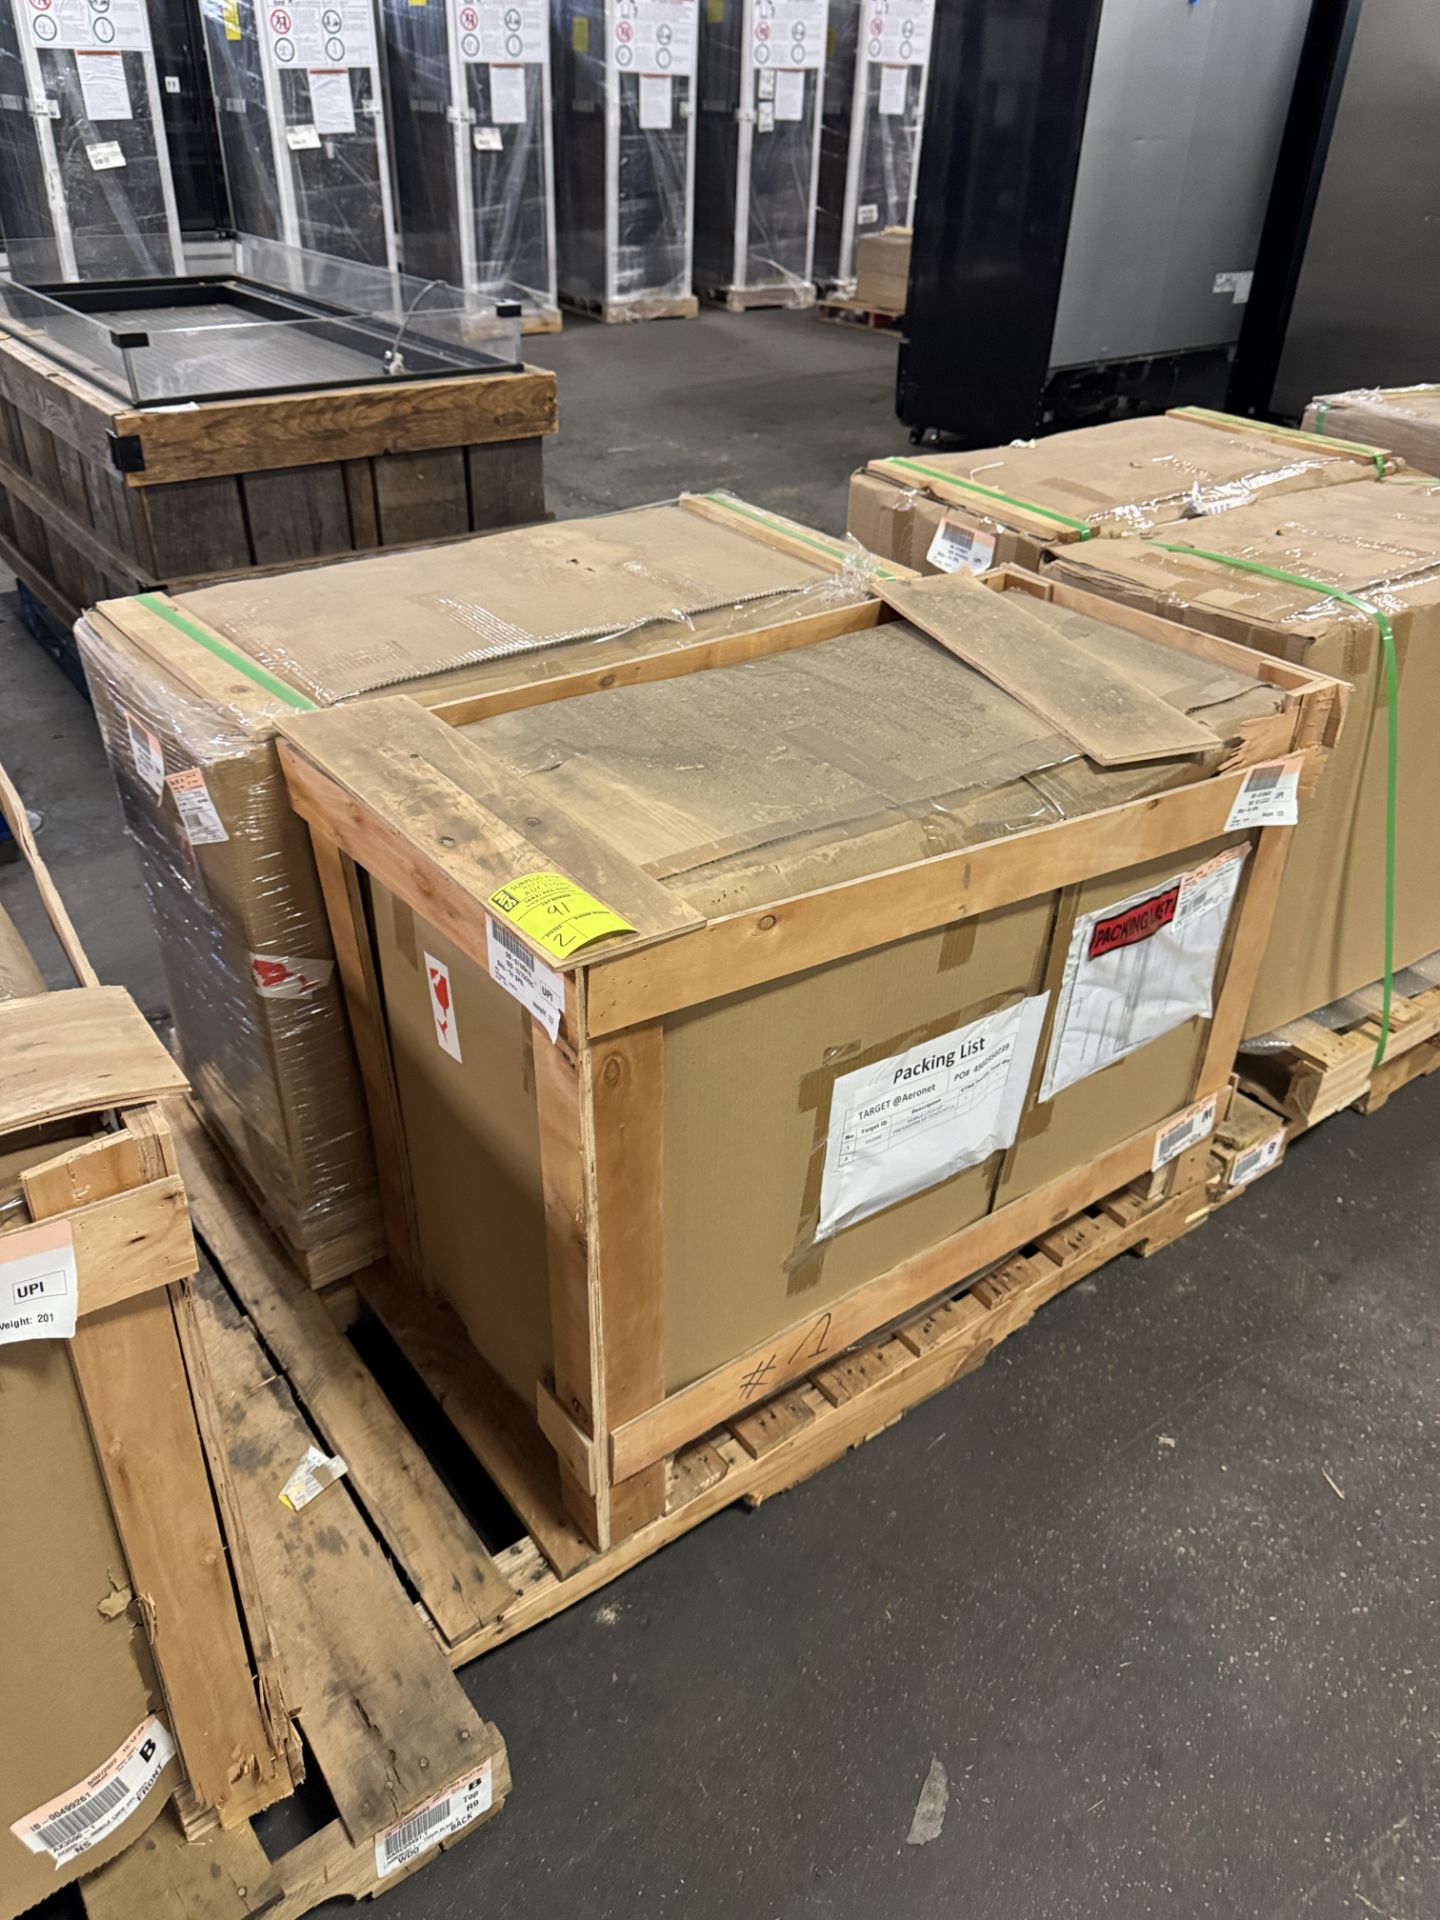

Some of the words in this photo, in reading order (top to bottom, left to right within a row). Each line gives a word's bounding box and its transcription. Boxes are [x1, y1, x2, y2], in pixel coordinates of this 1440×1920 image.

[547, 902, 570, 916] 91
[1095, 911, 1148, 947] PACKING
[553, 933, 577, 948] 2
[541, 985, 553, 1001] UPI
[893, 1050, 956, 1085] Packing
[960, 1037, 986, 1060] List
[858, 1099, 891, 1120] TARGET
[892, 1083, 936, 1107] @Aeronet
[861, 1123, 880, 1135] Target
[880, 1119, 888, 1127] ID
[17, 1281, 44, 1298] UPI
[37, 1313, 54, 1323] 201
[139, 1738, 156, 1763] B
[137, 1763, 162, 1801] FRONT
[468, 1777, 482, 1791] B
[463, 1790, 479, 1803] Top
[450, 1813, 473, 1832] BACK
